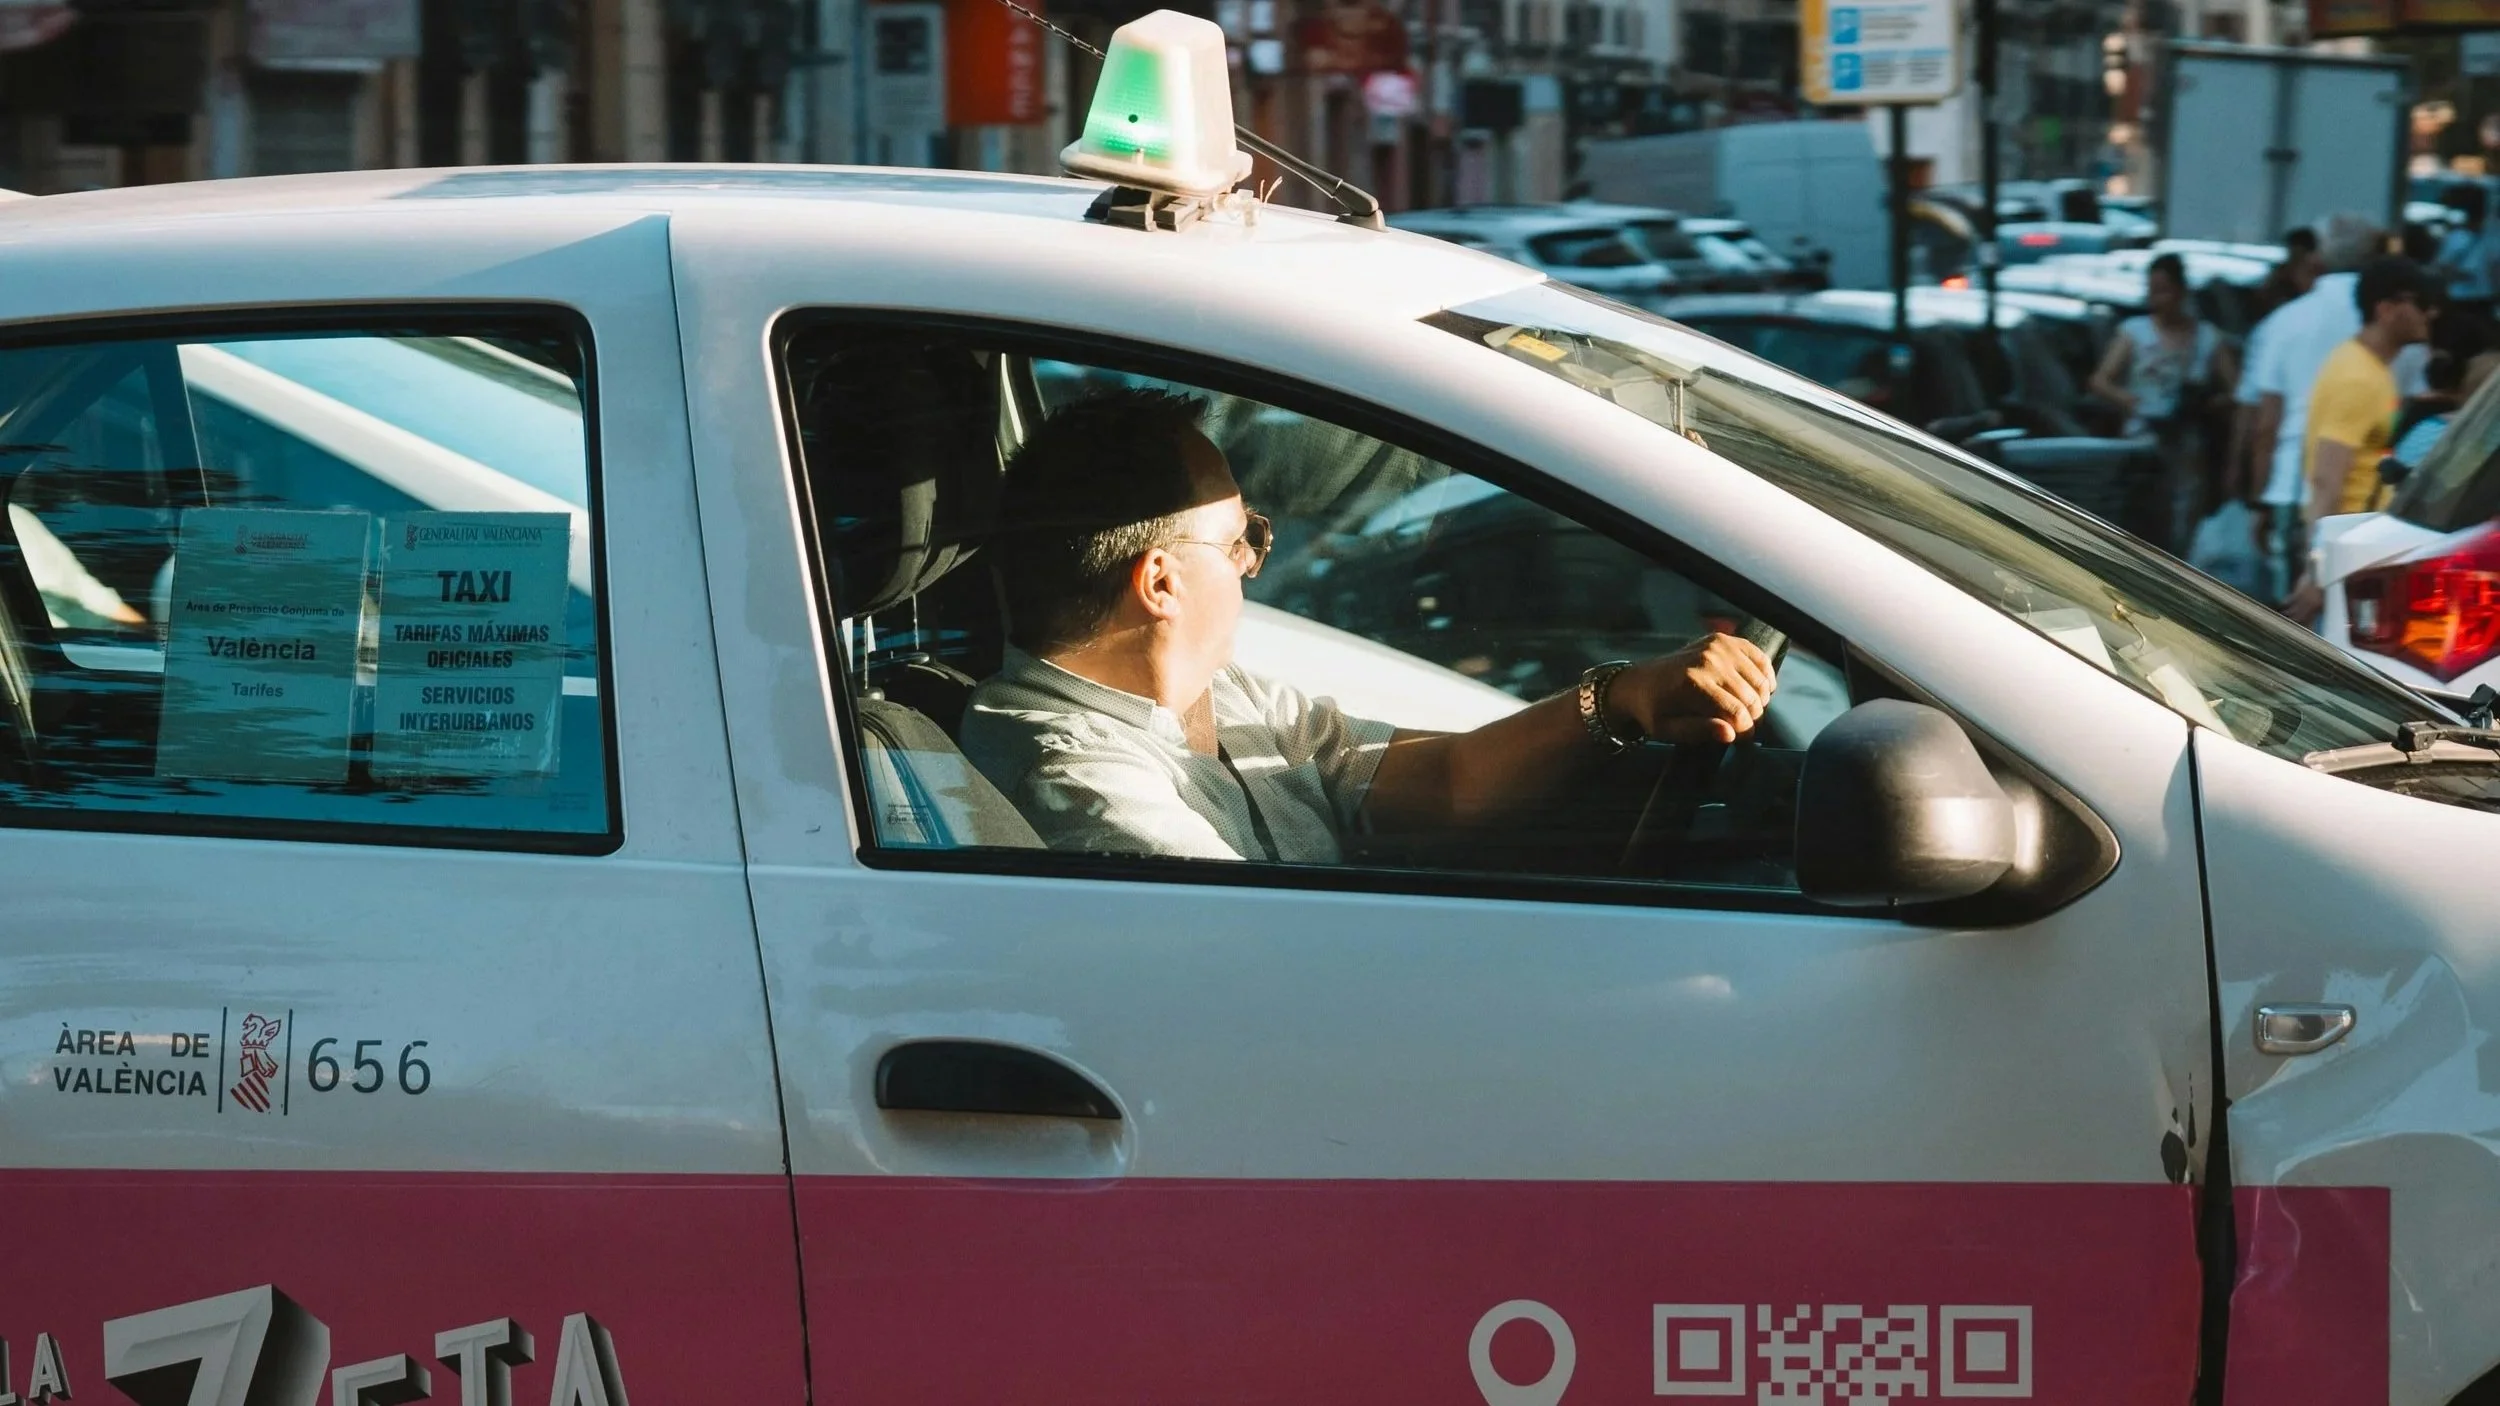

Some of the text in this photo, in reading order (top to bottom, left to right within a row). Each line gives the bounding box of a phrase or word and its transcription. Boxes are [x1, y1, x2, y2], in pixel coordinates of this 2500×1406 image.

[419, 527, 543, 542] GENERALITAT VALENCIANA
[438, 570, 512, 603] TAXI
[212, 602, 226, 612] de
[281, 605, 328, 618] Conjunta
[332, 606, 345, 617] de
[394, 620, 550, 643] TARIFAS MÁXIMAS
[207, 636, 316, 660] València
[427, 650, 513, 668] OFICIALES
[232, 683, 284, 698] Tarifes
[422, 687, 515, 705] SERVICIOS
[400, 712, 534, 731] INTERURBANOS
[55, 1022, 210, 1058] ÀREA DE
[307, 1037, 431, 1095] 656
[53, 1061, 207, 1096] VALÈNCIA
